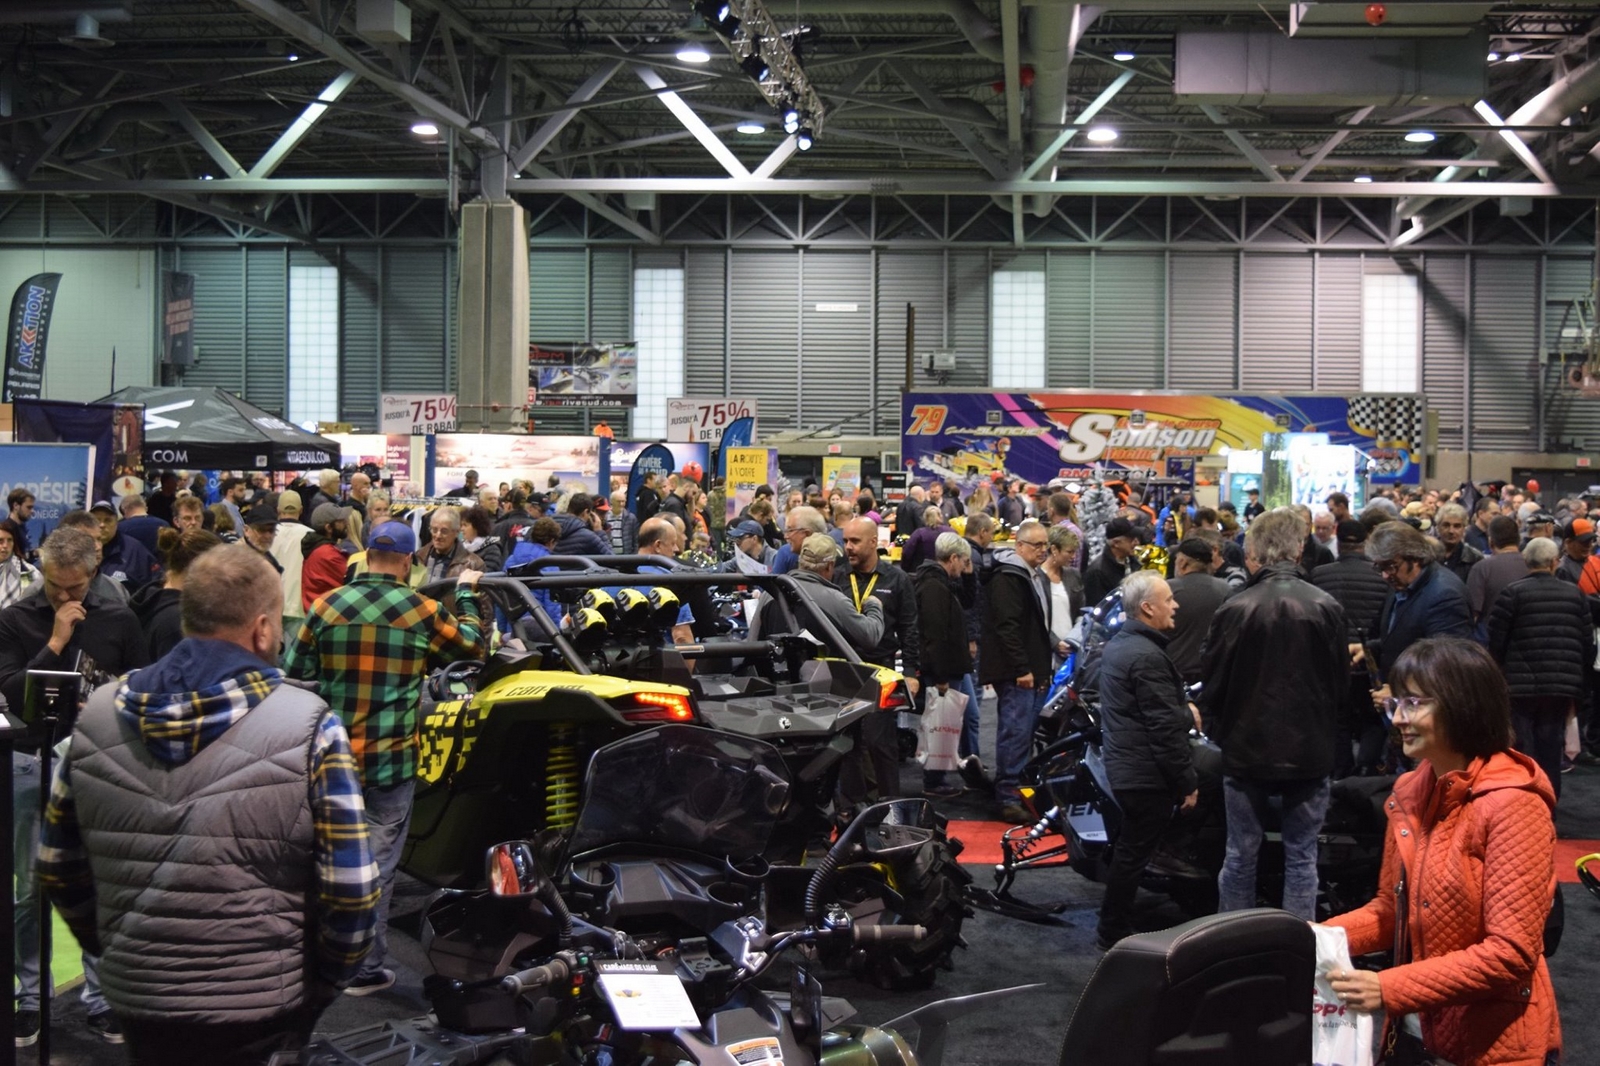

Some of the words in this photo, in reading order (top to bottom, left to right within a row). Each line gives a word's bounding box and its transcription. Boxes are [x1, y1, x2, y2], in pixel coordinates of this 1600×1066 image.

[410, 396, 456, 423] 75%
[698, 401, 750, 428] 75%
[906, 405, 948, 435] 79
[412, 424, 425, 435] DE
[700, 429, 713, 440] DE
[1059, 413, 1217, 463] Samson
[739, 454, 764, 464] ROUTE
